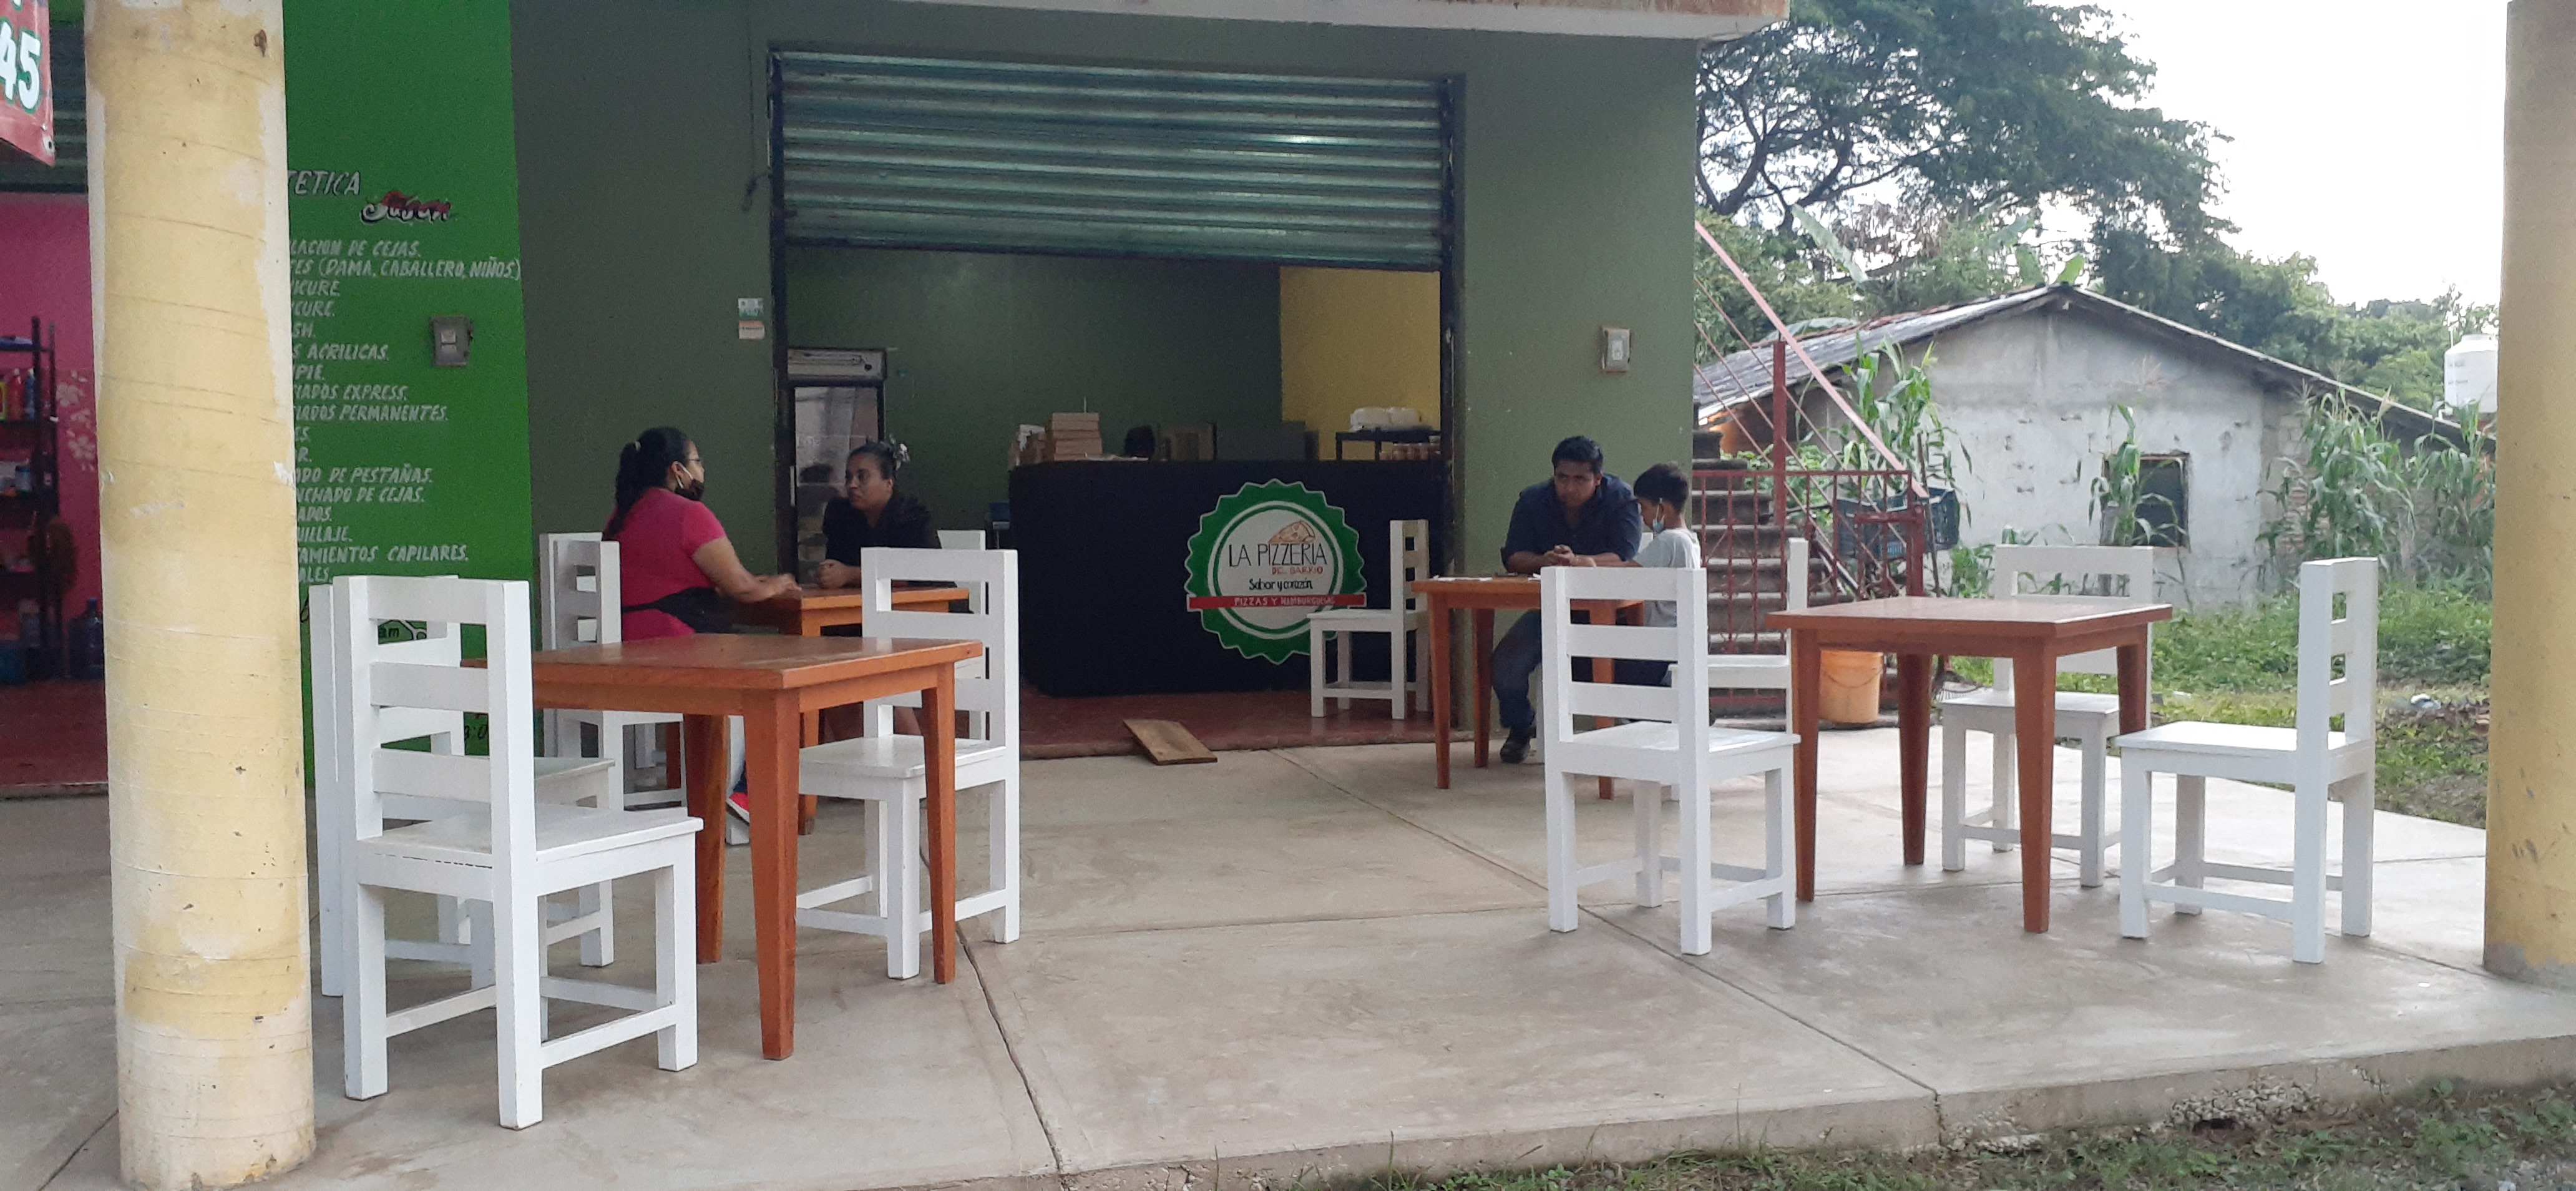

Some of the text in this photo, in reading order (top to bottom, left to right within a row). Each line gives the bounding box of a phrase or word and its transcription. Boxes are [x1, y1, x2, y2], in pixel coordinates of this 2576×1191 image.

[288, 170, 360, 195] TETICA
[348, 240, 368, 257] DE
[290, 259, 314, 275] TES
[291, 280, 340, 297] ICURE.
[292, 323, 316, 338] SH.
[307, 343, 389, 361] ACRILICAS.
[293, 364, 324, 380] PIE.
[343, 385, 408, 400] EXPRESS.
[339, 404, 449, 421] PERMANENTES.
[329, 468, 348, 483] DE
[350, 463, 432, 483] PESTAÑAS.
[296, 486, 425, 503] NCHADO DE CEJAS.
[298, 506, 332, 522] ADOS.
[298, 526, 353, 542] UILLAJE.
[298, 544, 469, 564] AMIENTOS CAPILARES.
[1228, 543, 1327, 567] LA PIZZERIA
[298, 566, 332, 583] ALES.
[1272, 566, 1324, 575] DEL BARRIO
[1249, 578, 1274, 591] Sabor
[1234, 597, 1269, 606] PIZZAS
[1271, 597, 1278, 605] Y
